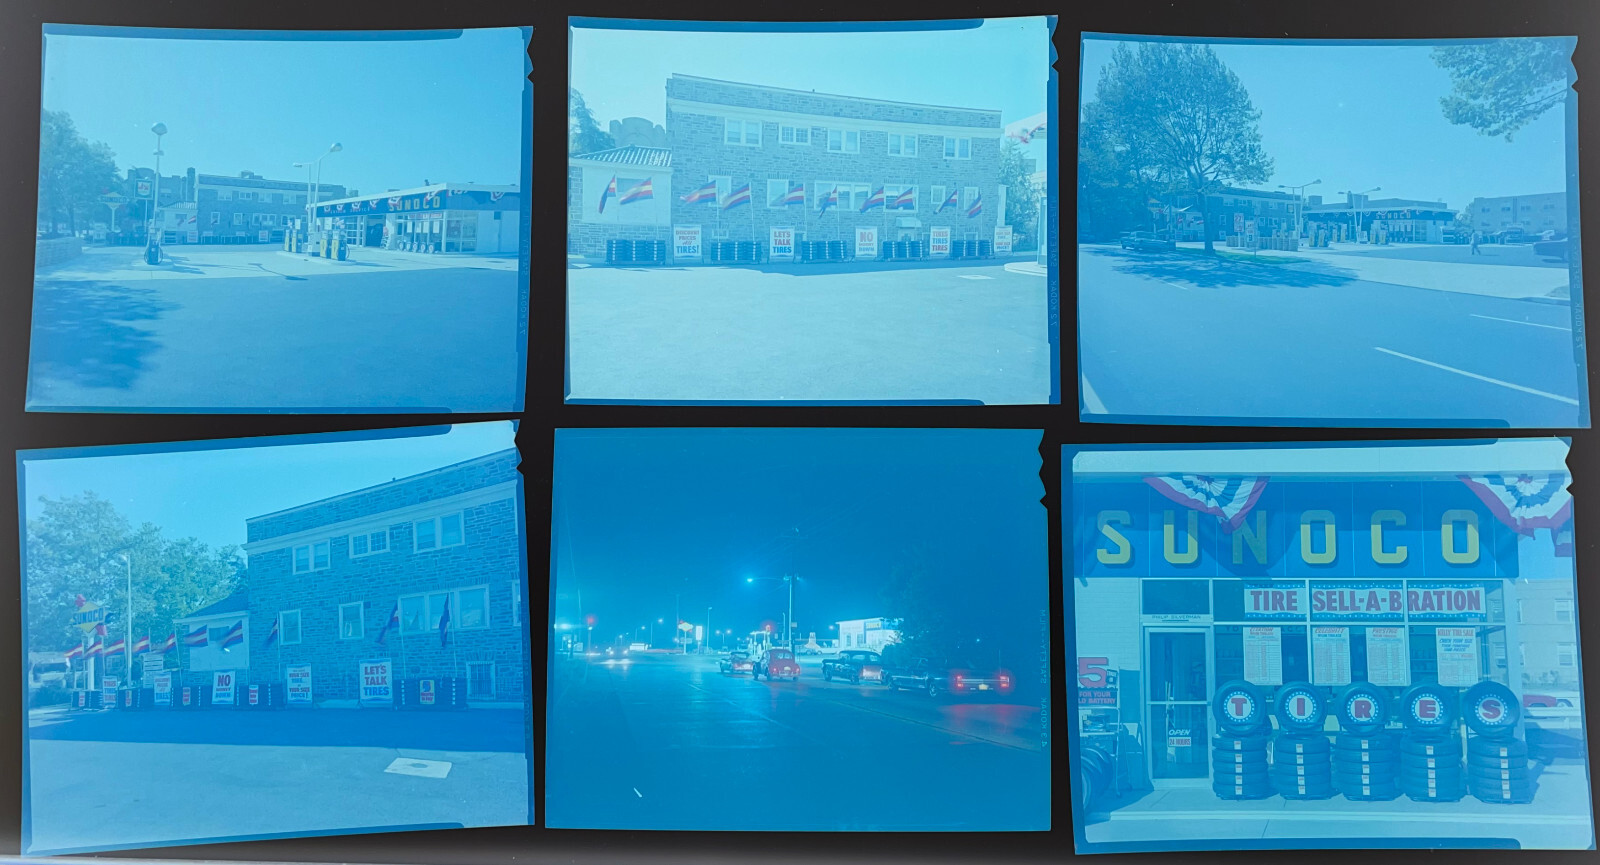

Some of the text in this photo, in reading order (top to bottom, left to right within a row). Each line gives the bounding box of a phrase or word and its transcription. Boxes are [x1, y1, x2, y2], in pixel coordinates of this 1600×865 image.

[860, 232, 873, 242] NO
[676, 245, 699, 254] TIRES!
[1096, 509, 1480, 565] SUNOCO
[1250, 590, 1298, 612] TIRE
[72, 608, 104, 625] SUNOCO
[364, 664, 386, 675] LET'S
[218, 674, 231, 687] NO
[364, 676, 387, 686] TALK
[363, 686, 390, 696] TIRES
[1176, 738, 1191, 746] HOURS
